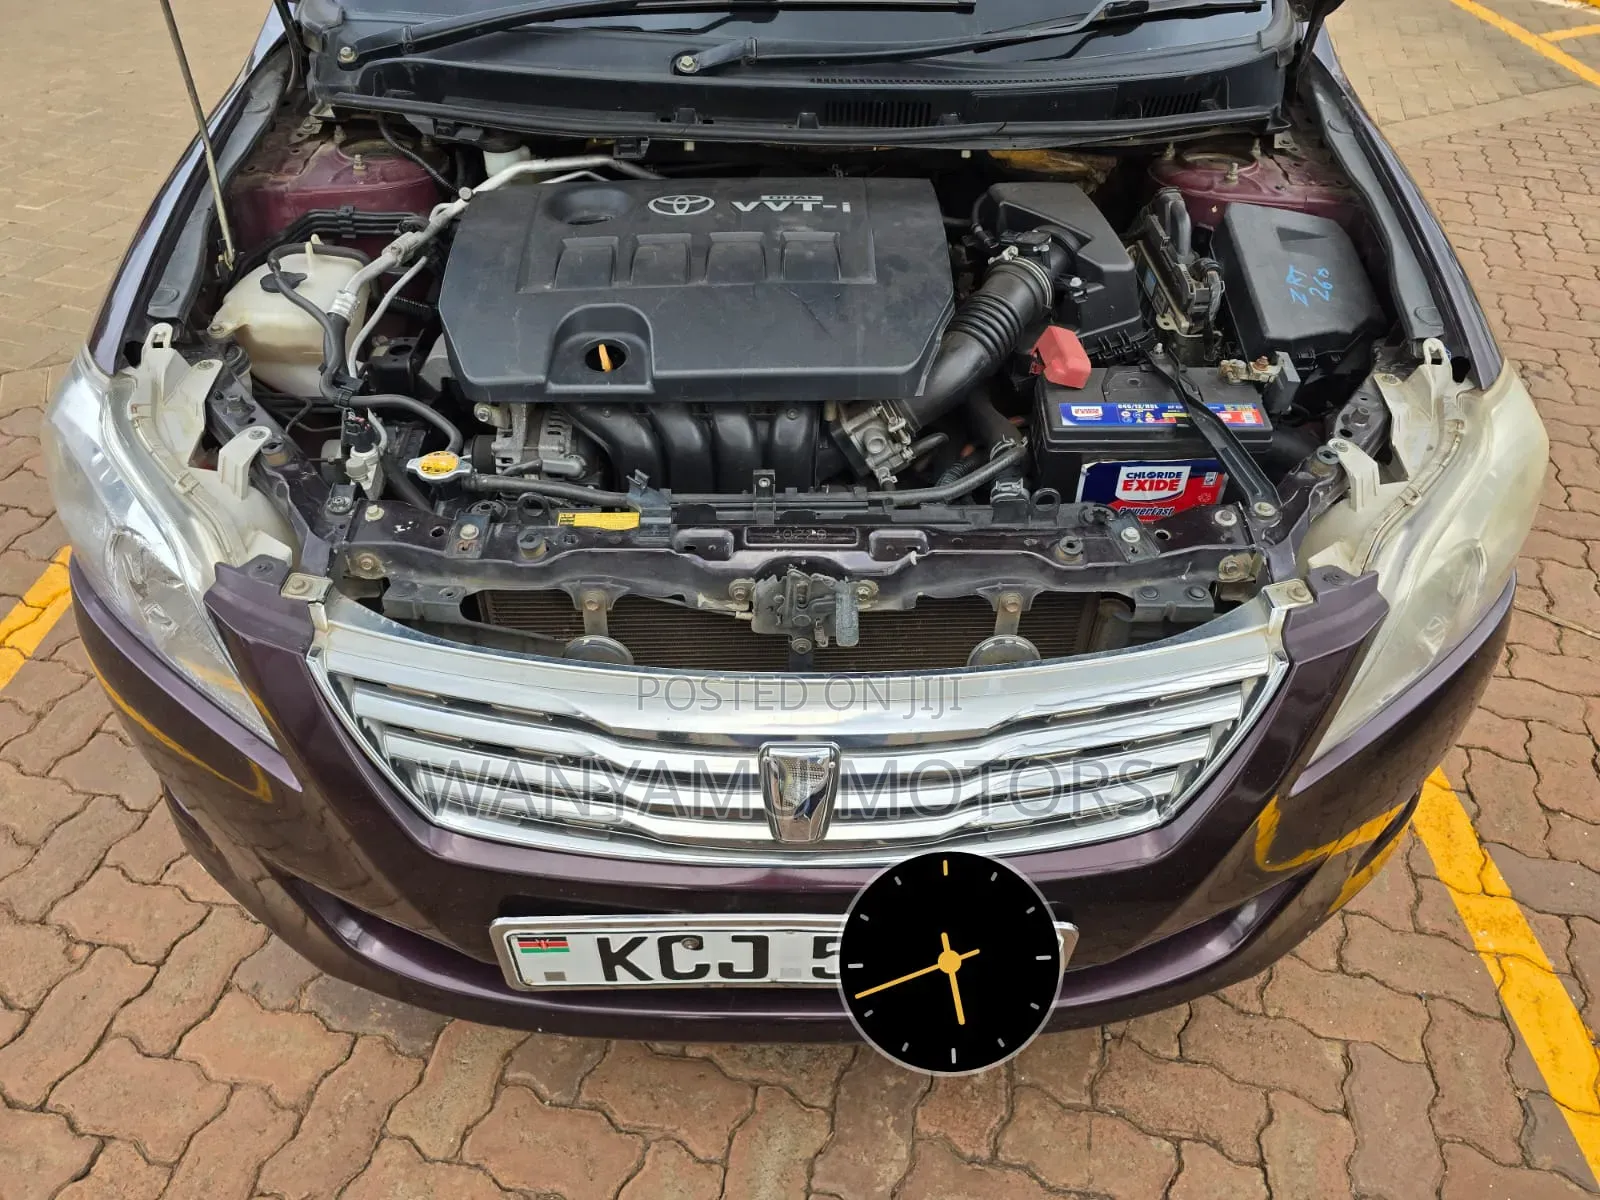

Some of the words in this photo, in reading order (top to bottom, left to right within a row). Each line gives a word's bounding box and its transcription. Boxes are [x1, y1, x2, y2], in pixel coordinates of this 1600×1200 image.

[1126, 471, 1183, 480] CHLORIDE
[1122, 480, 1181, 491] EXIDE
[596, 934, 770, 982] KCJ
